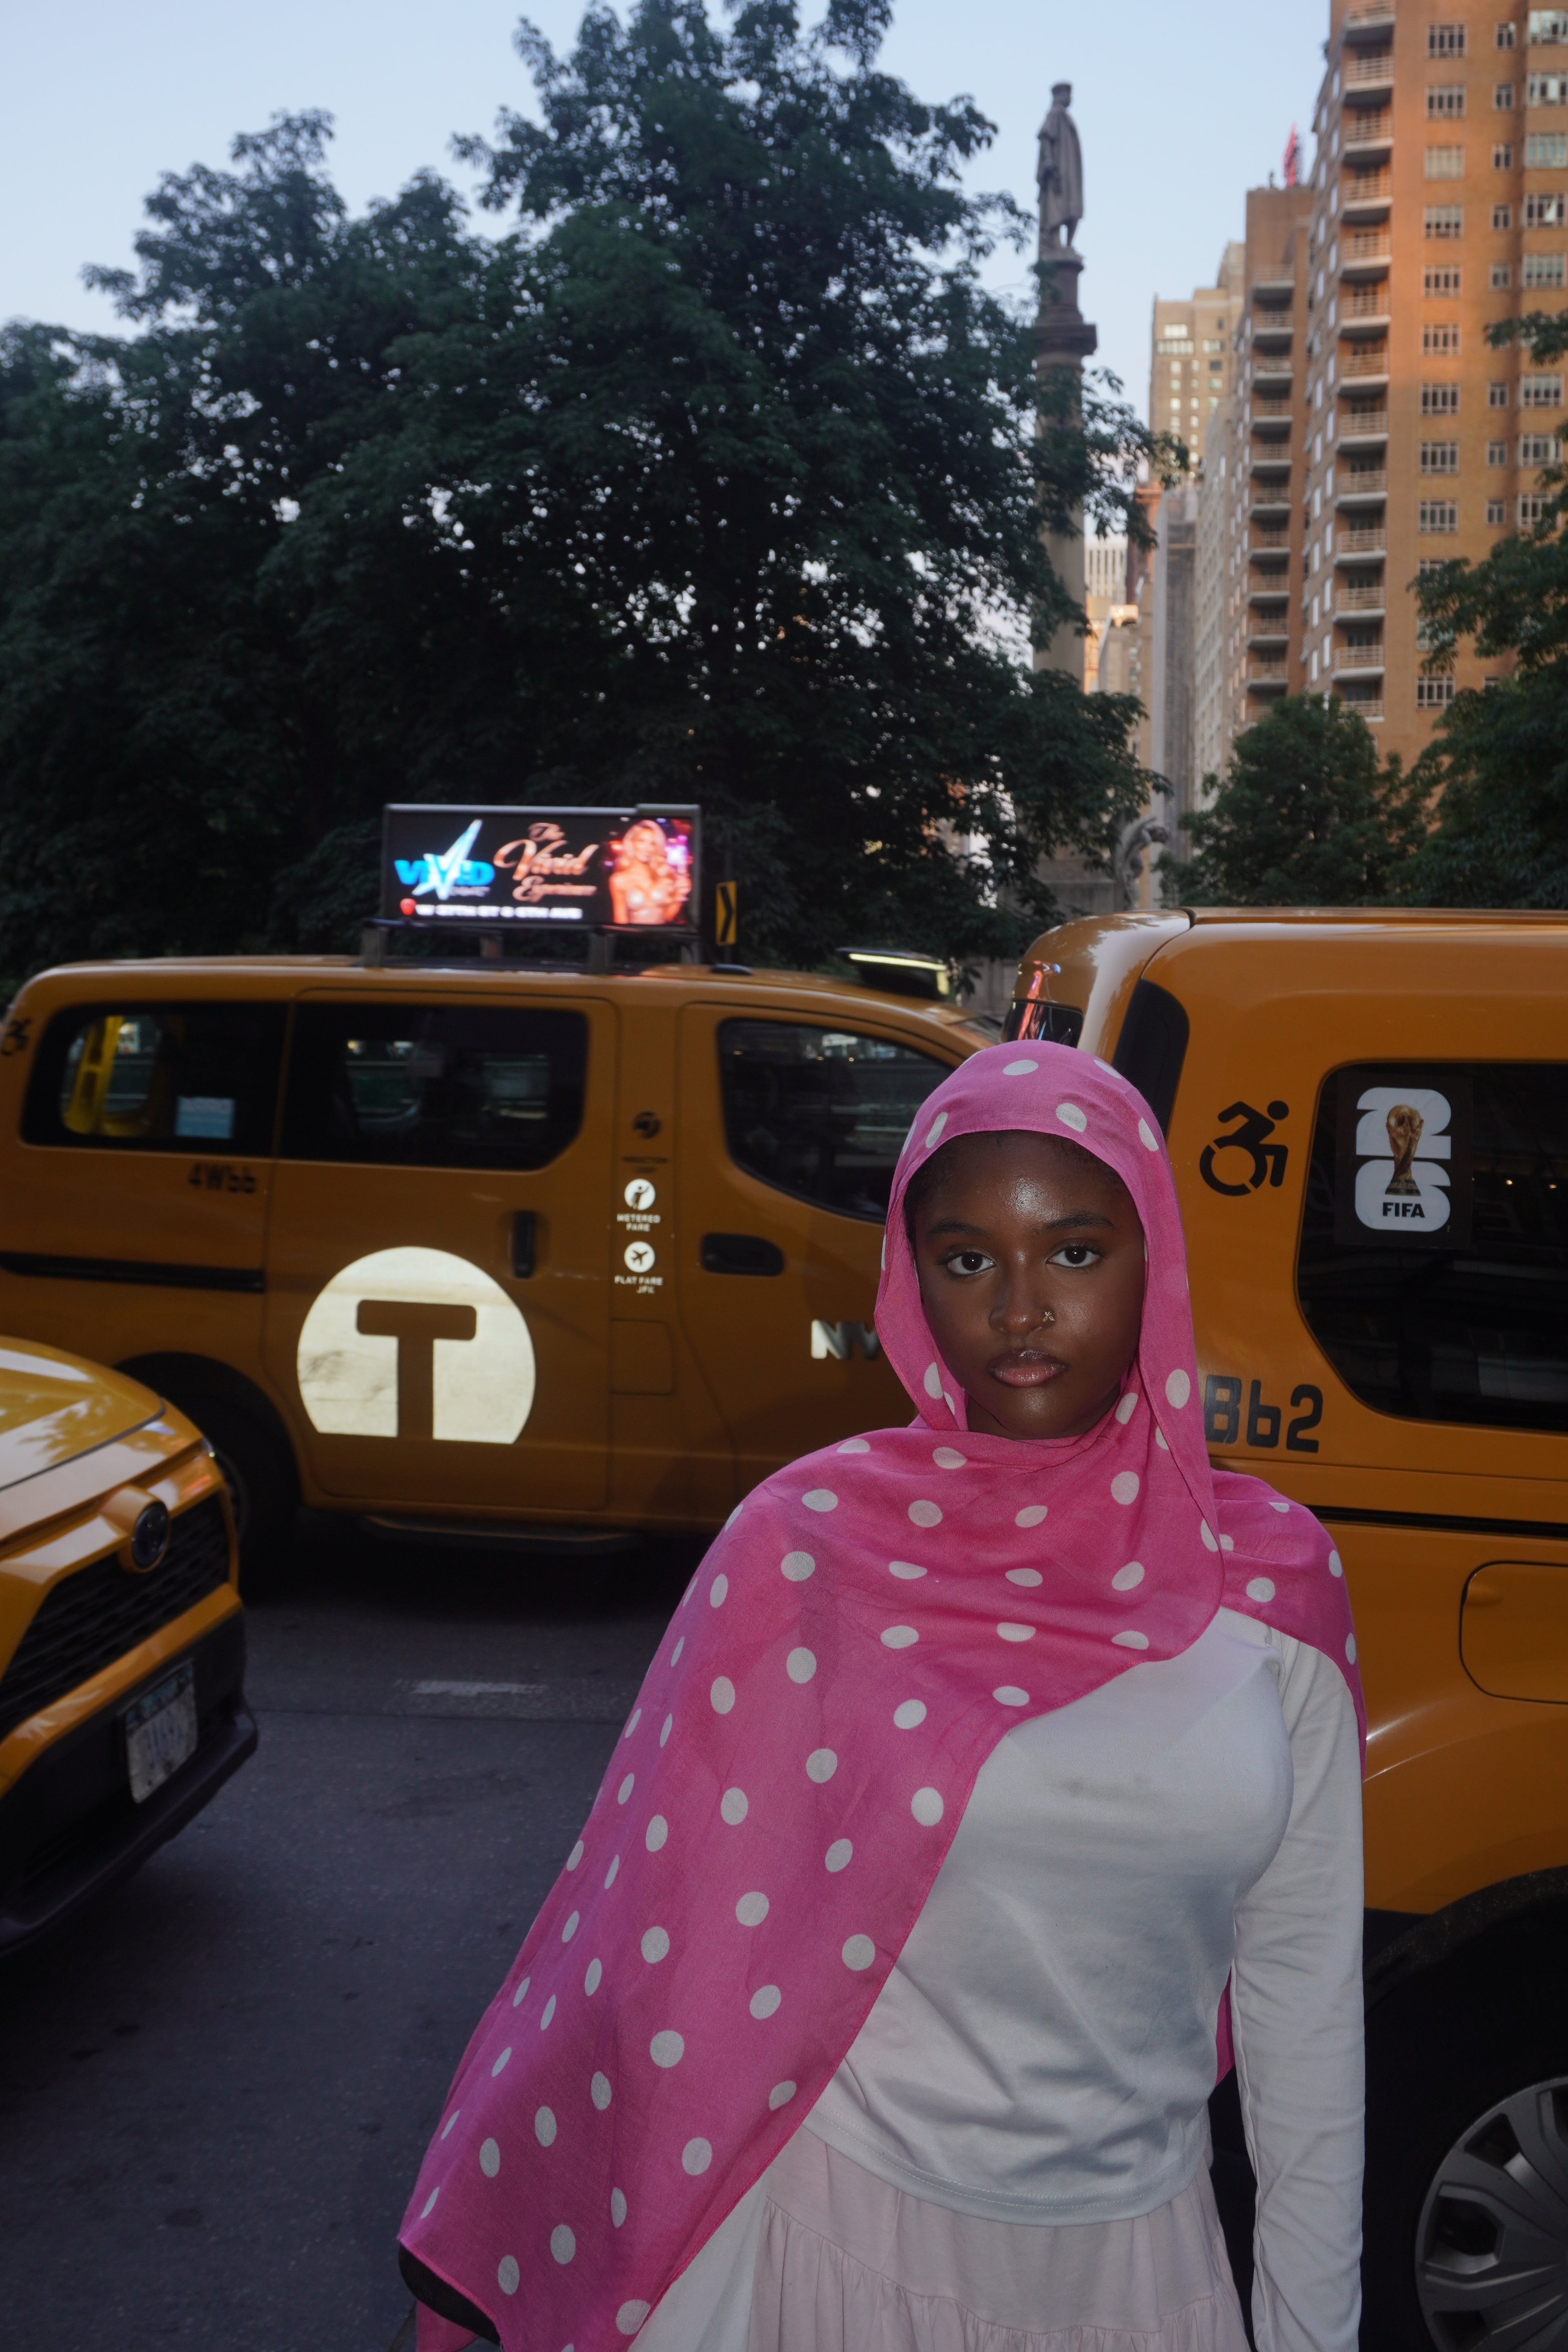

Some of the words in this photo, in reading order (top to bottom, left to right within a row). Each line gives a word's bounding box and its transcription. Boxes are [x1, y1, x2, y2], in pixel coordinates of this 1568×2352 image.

[1383, 1202, 1425, 1218] FIFA
[617, 1214, 661, 1223] METERED
[626, 1223, 650, 1232] FARE
[615, 1276, 637, 1285] FLAT
[639, 1276, 663, 1286] FARE
